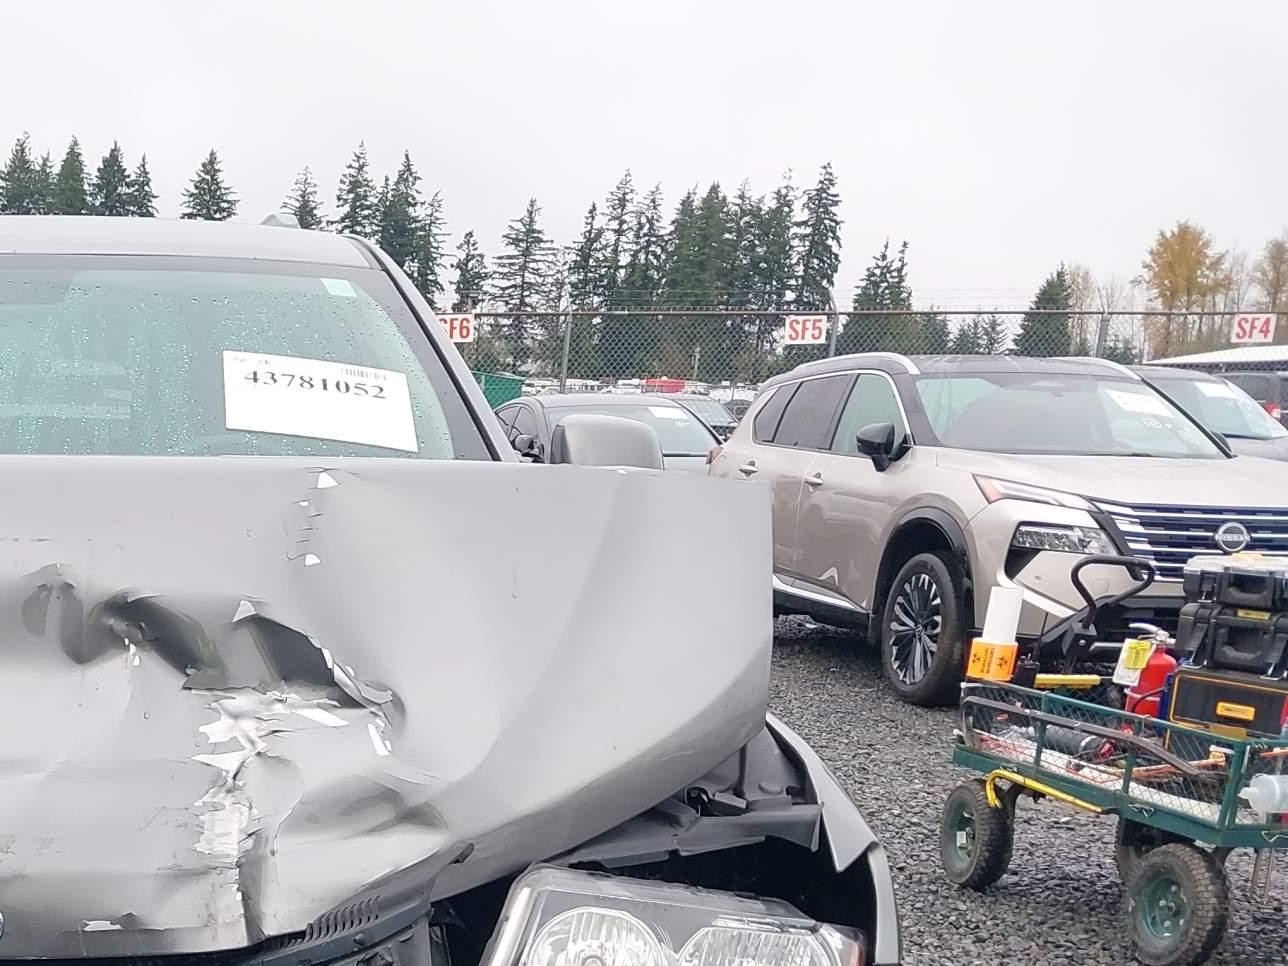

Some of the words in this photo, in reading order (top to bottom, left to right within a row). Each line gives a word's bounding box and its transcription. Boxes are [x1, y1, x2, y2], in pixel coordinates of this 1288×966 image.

[787, 318, 823, 341] SF5
[1235, 317, 1271, 339] SF4
[243, 370, 388, 400] 43781052
